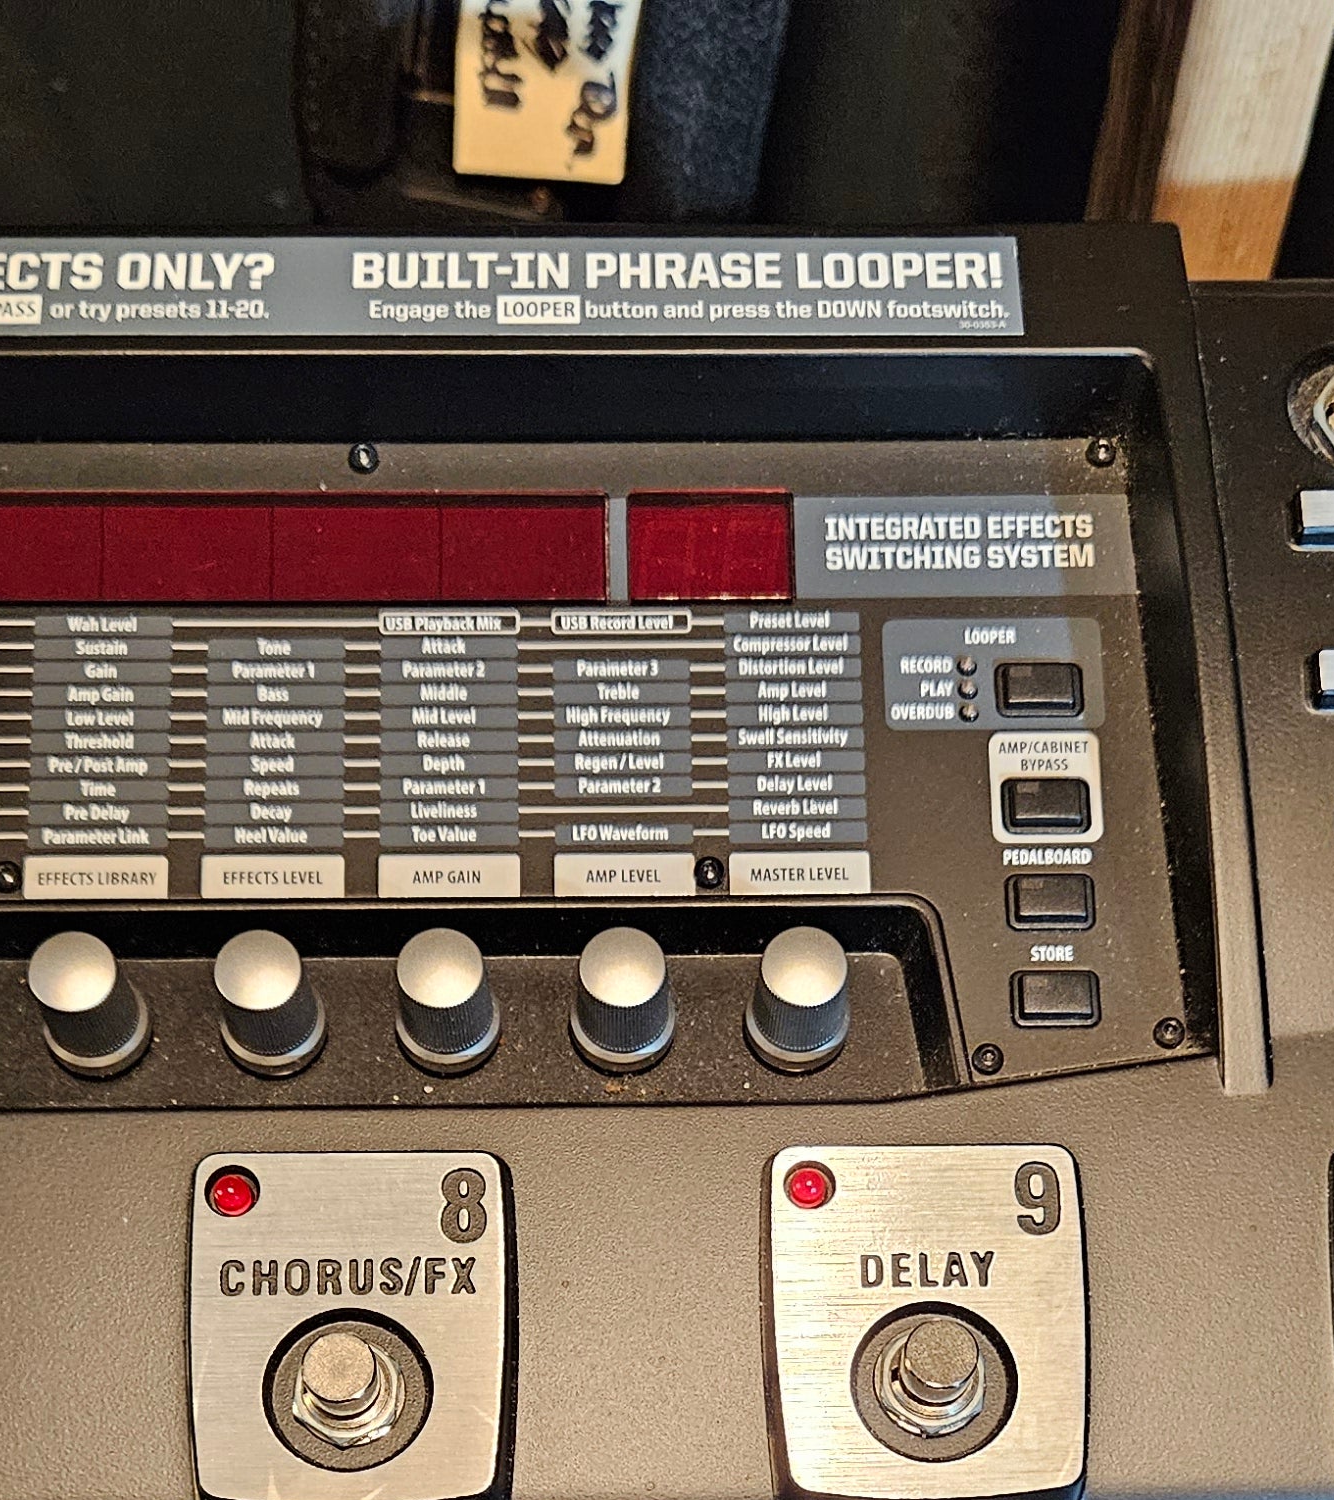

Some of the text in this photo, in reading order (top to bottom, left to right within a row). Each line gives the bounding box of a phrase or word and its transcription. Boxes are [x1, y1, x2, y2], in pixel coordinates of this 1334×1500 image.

[116, 252, 275, 291] ONLY?
[351, 252, 1004, 290] BUILT-IN PHRASE LOOPER!
[49, 302, 75, 320] or
[78, 301, 113, 324] try
[116, 300, 203, 323] presets
[204, 299, 270, 320] 11-20.
[369, 299, 1011, 323] Engage the LOOPER button and press the DOWN footswitch.
[824, 514, 1093, 541] INTEGRATED EFFECTS
[825, 543, 1095, 571] SWITCHING SYSTEM
[386, 617, 501, 632] USB Playback Mix
[561, 615, 673, 629] USB Record Level
[749, 611, 829, 629] Preset Level
[733, 635, 848, 654] Compressor Level
[964, 628, 1017, 644] LOOPER
[76, 641, 128, 656] Sustain
[257, 638, 291, 656] Tone
[421, 639, 466, 654] Attack
[738, 658, 844, 675] Distortion Level
[900, 656, 954, 674] RECORD
[419, 685, 468, 701] Middle
[597, 684, 639, 699] Treble
[920, 681, 954, 697] PLAY
[891, 704, 954, 721] OVERDUB
[65, 734, 134, 749] Threshold
[249, 732, 295, 749] Attack
[417, 732, 469, 748] Release
[578, 731, 661, 747] Attenuation
[999, 741, 1088, 754] AMP/CABINET
[250, 756, 294, 774] Speed
[422, 756, 465, 774] Depth
[1021, 758, 1068, 771] BYPASS
[243, 779, 299, 798] Repeats
[757, 775, 833, 794] Delay Level
[249, 803, 292, 822] Decay
[410, 802, 477, 819] Liveliness
[753, 799, 838, 816] Reverb Level
[1002, 849, 1092, 866] PEDALBOARD
[38, 872, 156, 886] EFFECTS LIBRARY
[223, 871, 323, 885] EFFECTS LEVEL
[413, 870, 481, 884] AMP GAIN
[586, 869, 661, 883] AMP LEVEL
[750, 867, 849, 882] MASTER LEVEL
[1030, 945, 1074, 962] STORE
[440, 1168, 488, 1244] 8
[1015, 1162, 1061, 1237] 9
[220, 1256, 477, 1296] CHORUS/FX
[860, 1251, 996, 1289] DELAY
